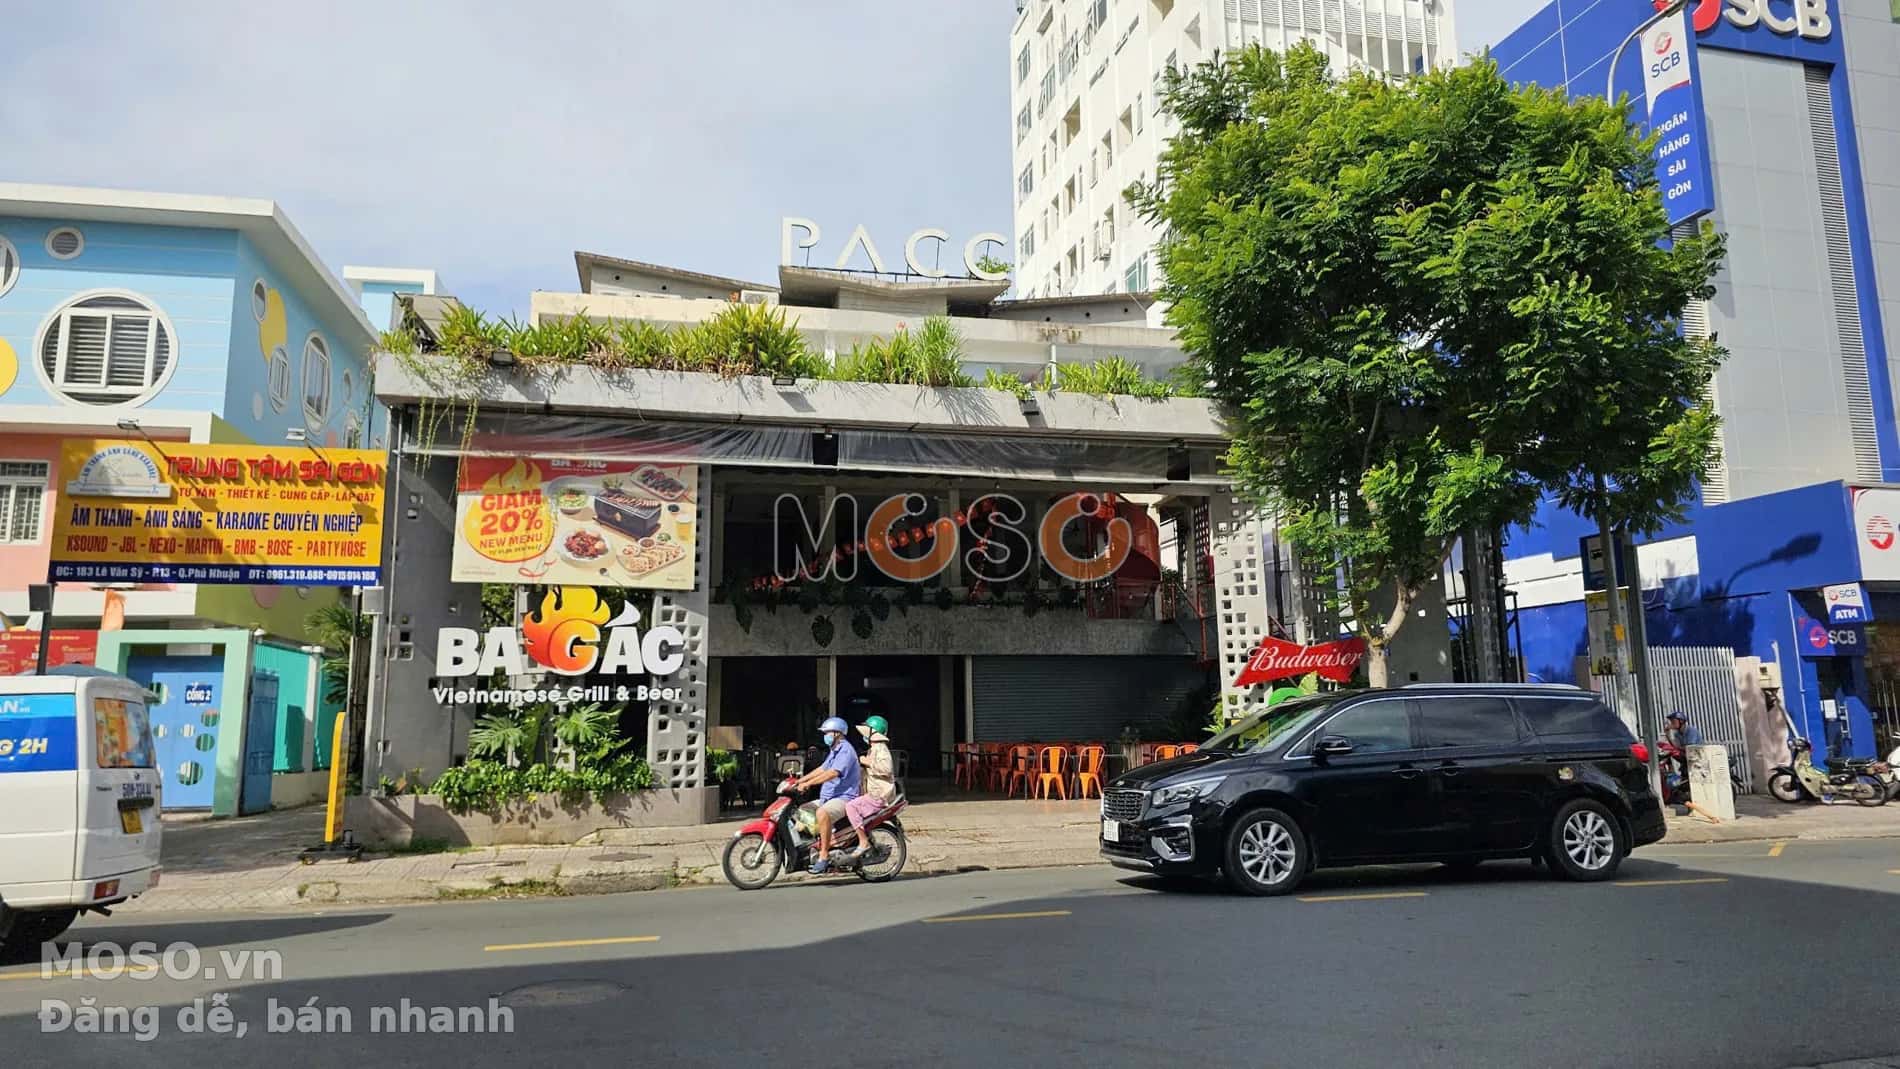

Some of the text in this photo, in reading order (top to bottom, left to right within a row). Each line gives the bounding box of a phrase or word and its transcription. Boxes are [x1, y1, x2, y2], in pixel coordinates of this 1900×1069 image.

[1722, 0, 1832, 39] SCB
[1651, 51, 1681, 78] SCB
[1659, 133, 1691, 159] HÀNG
[1667, 158, 1687, 177] SÀI
[1668, 180, 1692, 200] GÒN
[166, 456, 239, 479] TRUNG
[246, 454, 293, 481] TÂM
[70, 503, 91, 527] ÂM
[95, 507, 133, 527] THANH
[172, 507, 203, 529] SÁNG
[216, 511, 270, 530] KARAOKE
[273, 510, 319, 532] CHUYÊN
[323, 511, 363, 536] NGHIỆP
[480, 507, 544, 536] 20%
[66, 535, 108, 552] KSOUND
[119, 536, 137, 553] JBL
[149, 537, 177, 554] NEXO
[184, 538, 223, 555] MARTIN
[234, 539, 256, 556] BMB
[267, 540, 293, 556] BOSE
[479, 532, 543, 549] NEW MENU
[1839, 589, 1857, 598] SCB
[1835, 607, 1859, 620] ATM
[1828, 630, 1857, 645] SCB
[1248, 644, 1363, 671] Budweiser
[433, 685, 682, 704] Vietnamese Grill & Beer
[18, 738, 48, 754] 2H
